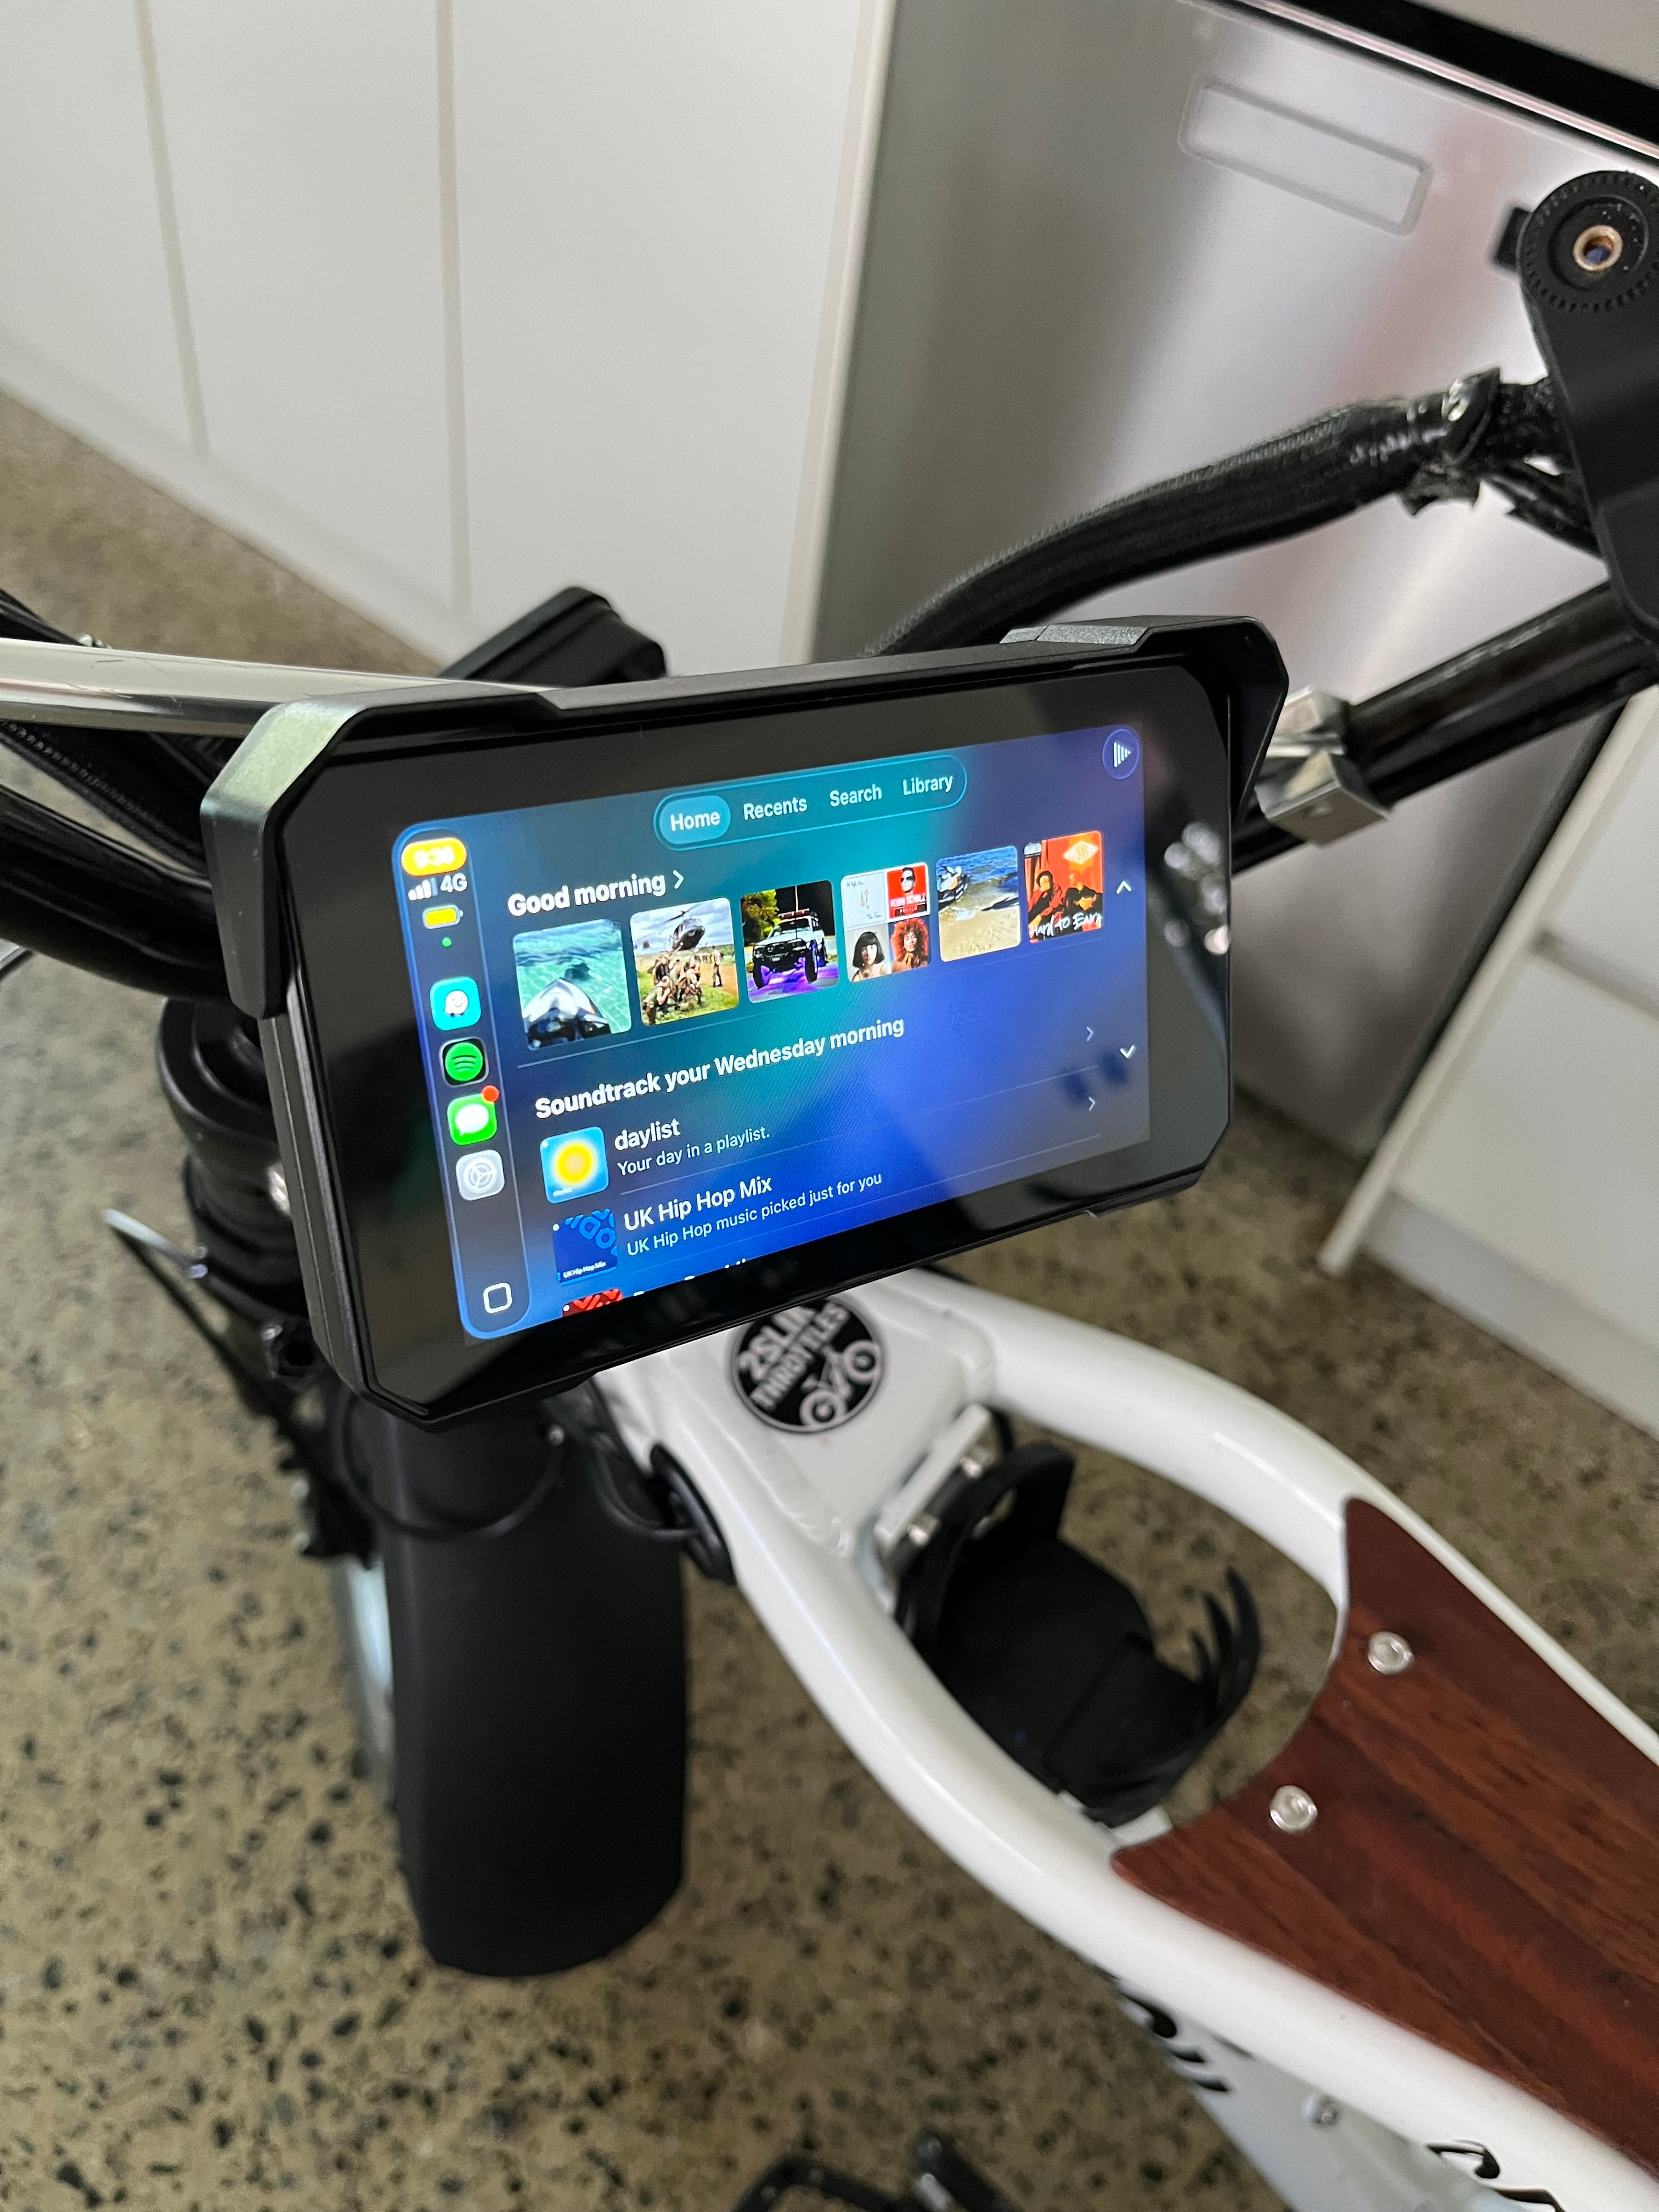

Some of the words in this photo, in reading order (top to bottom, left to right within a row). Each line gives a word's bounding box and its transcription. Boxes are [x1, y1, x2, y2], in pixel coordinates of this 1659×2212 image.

[830, 784, 882, 806] Search
[903, 776, 953, 795] Library
[670, 812, 720, 831] Home
[743, 797, 807, 820] Recents
[441, 873, 467, 892] 4G
[508, 885, 570, 916] Good
[574, 874, 665, 905] morning
[535, 1073, 661, 1118] Soundtrack
[664, 1064, 710, 1092] your
[714, 1037, 825, 1075] Wednesday
[830, 1019, 904, 1049] morning
[615, 1119, 680, 1150] daylist
[617, 1158, 652, 1175] Your
[657, 1150, 682, 1165] day
[687, 1144, 699, 1158] in
[704, 1143, 712, 1153] a
[717, 1127, 769, 1153] playlist.
[624, 1207, 654, 1230] UK
[658, 1199, 691, 1221] Hip
[697, 1189, 735, 1211] Hop
[740, 1176, 772, 1199] Mix
[627, 1238, 650, 1255] UK
[653, 1232, 678, 1248] Hip
[682, 1223, 712, 1240] Hop
[716, 1209, 757, 1230] music
[761, 1193, 805, 1220] picked
[809, 1186, 833, 1206] just
[837, 1181, 855, 1195] for
[859, 1174, 881, 1192] you
